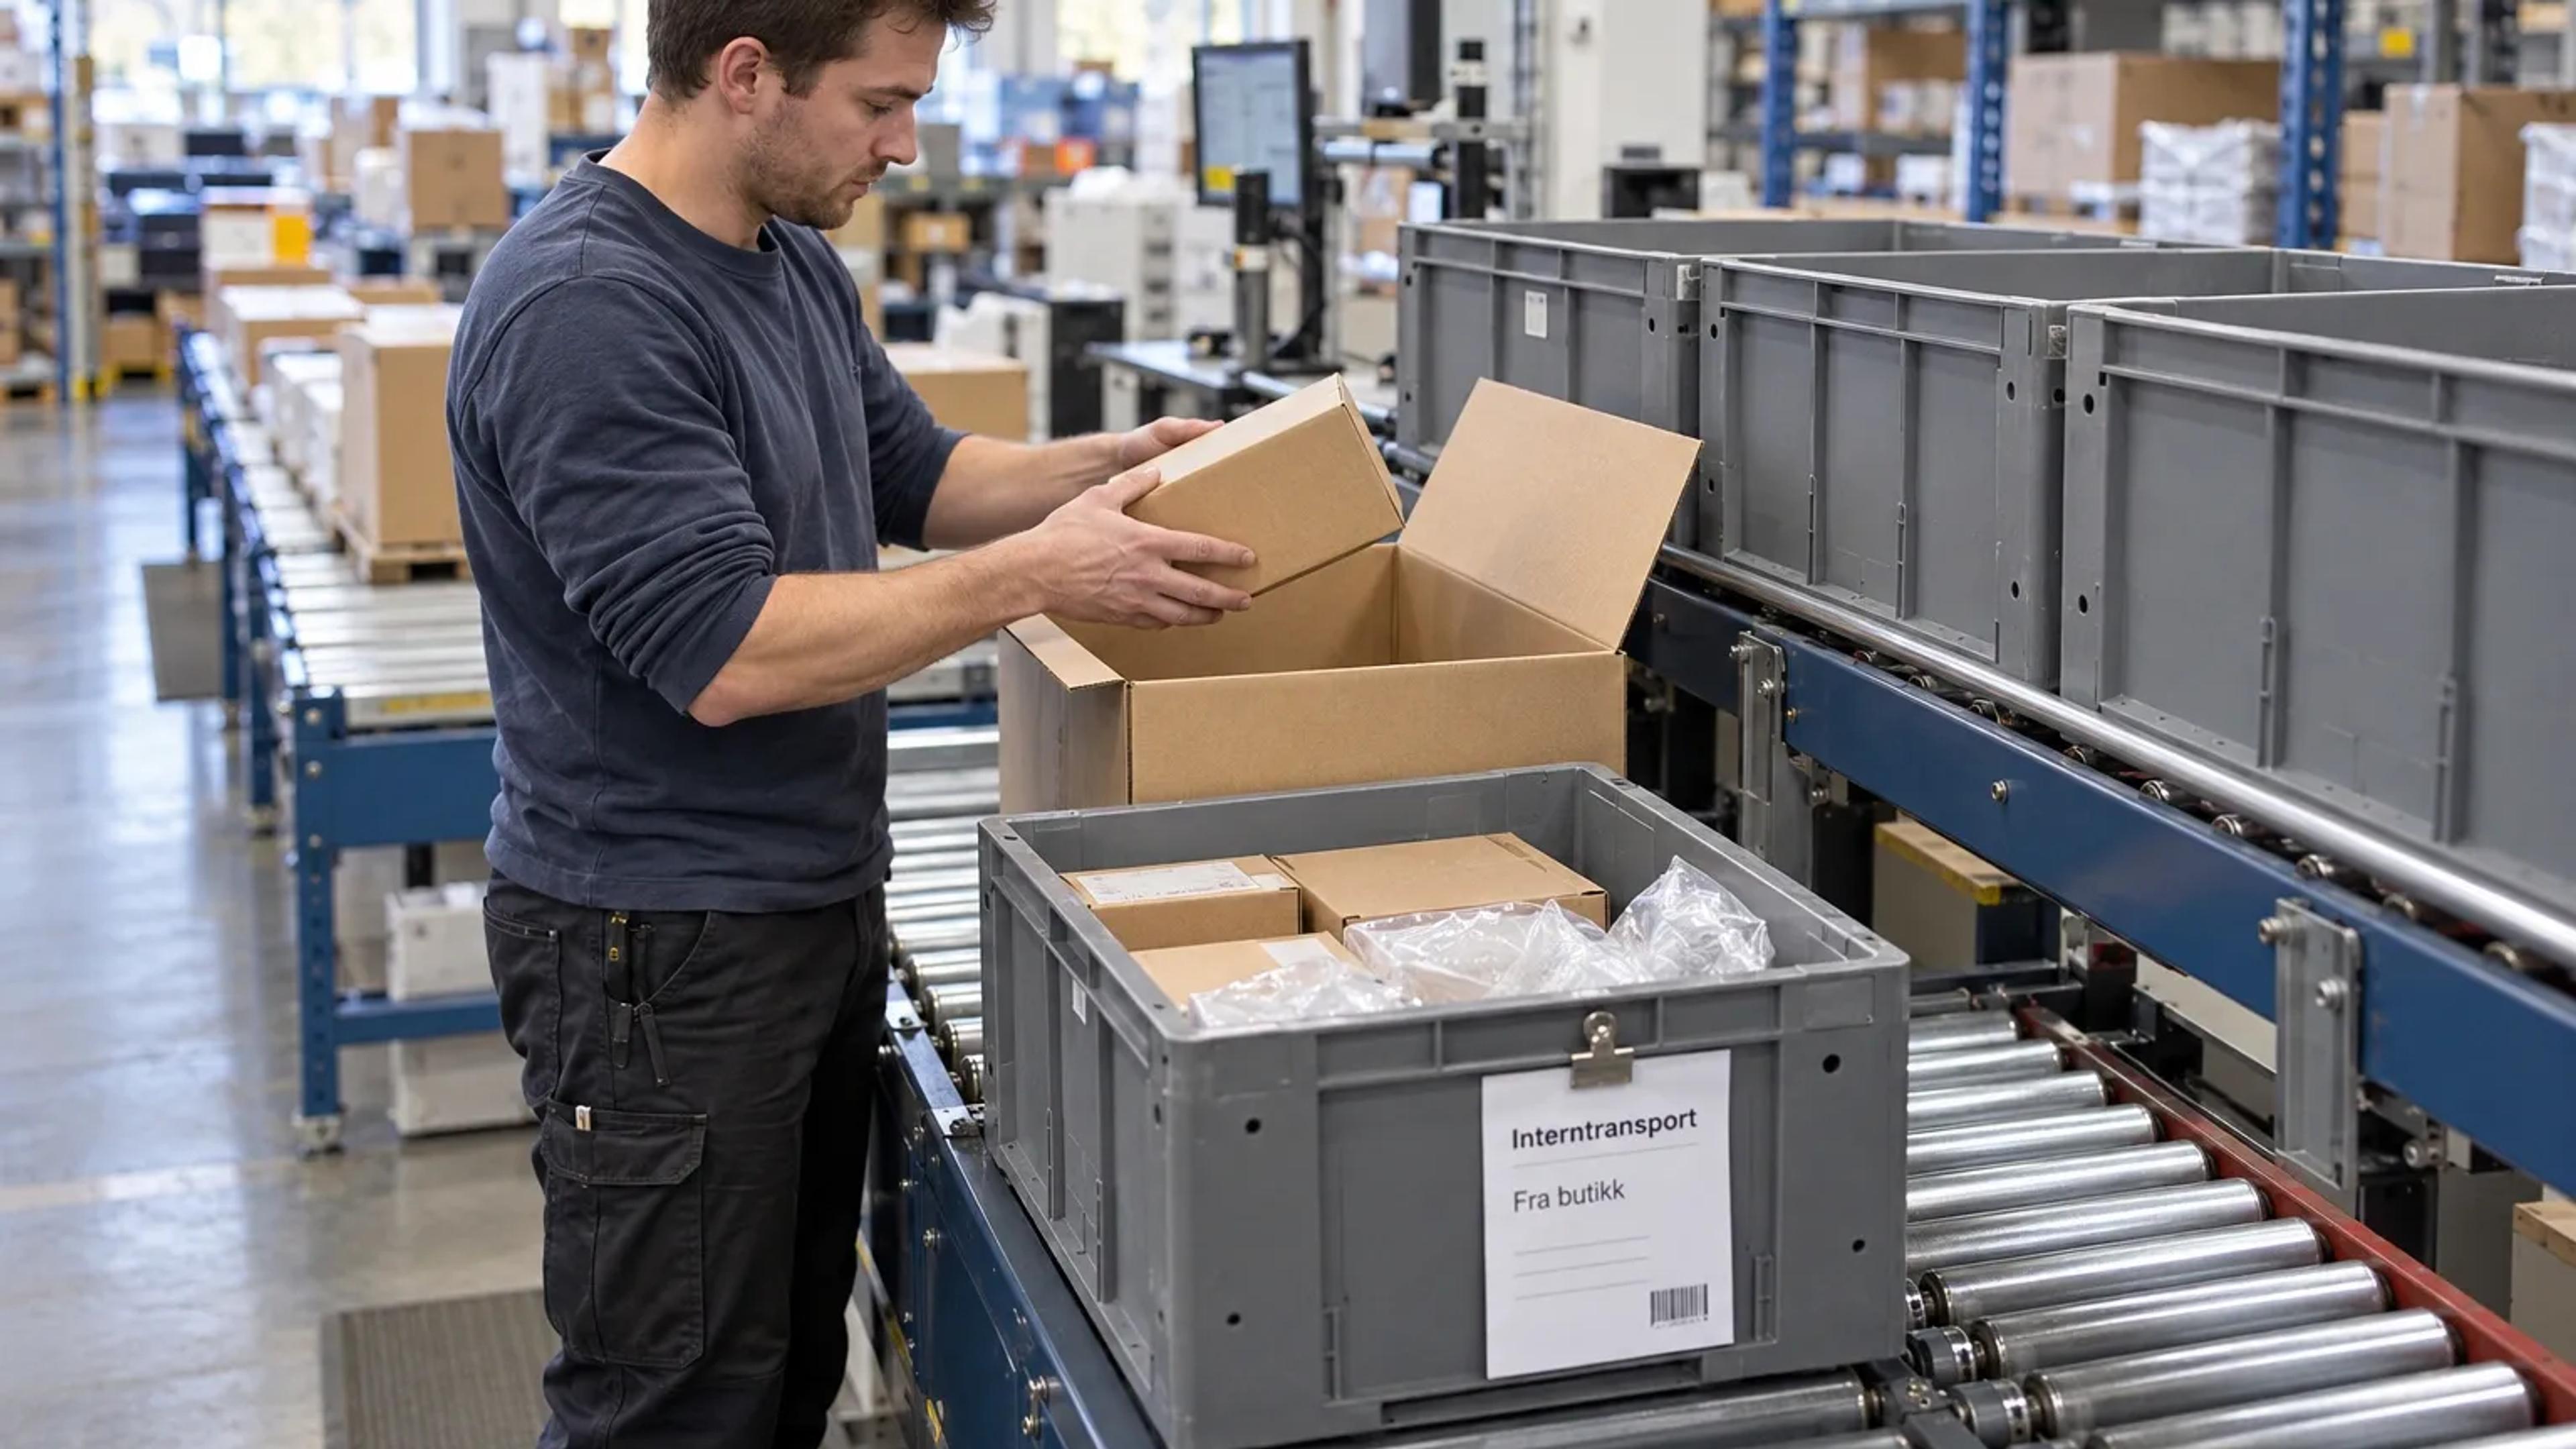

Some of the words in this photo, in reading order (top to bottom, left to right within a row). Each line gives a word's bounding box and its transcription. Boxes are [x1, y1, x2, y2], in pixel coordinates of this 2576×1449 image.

[1512, 1108, 1698, 1150] Interntransport
[1514, 1190, 1550, 1212] Fra
[1558, 1179, 1625, 1207] butikk
